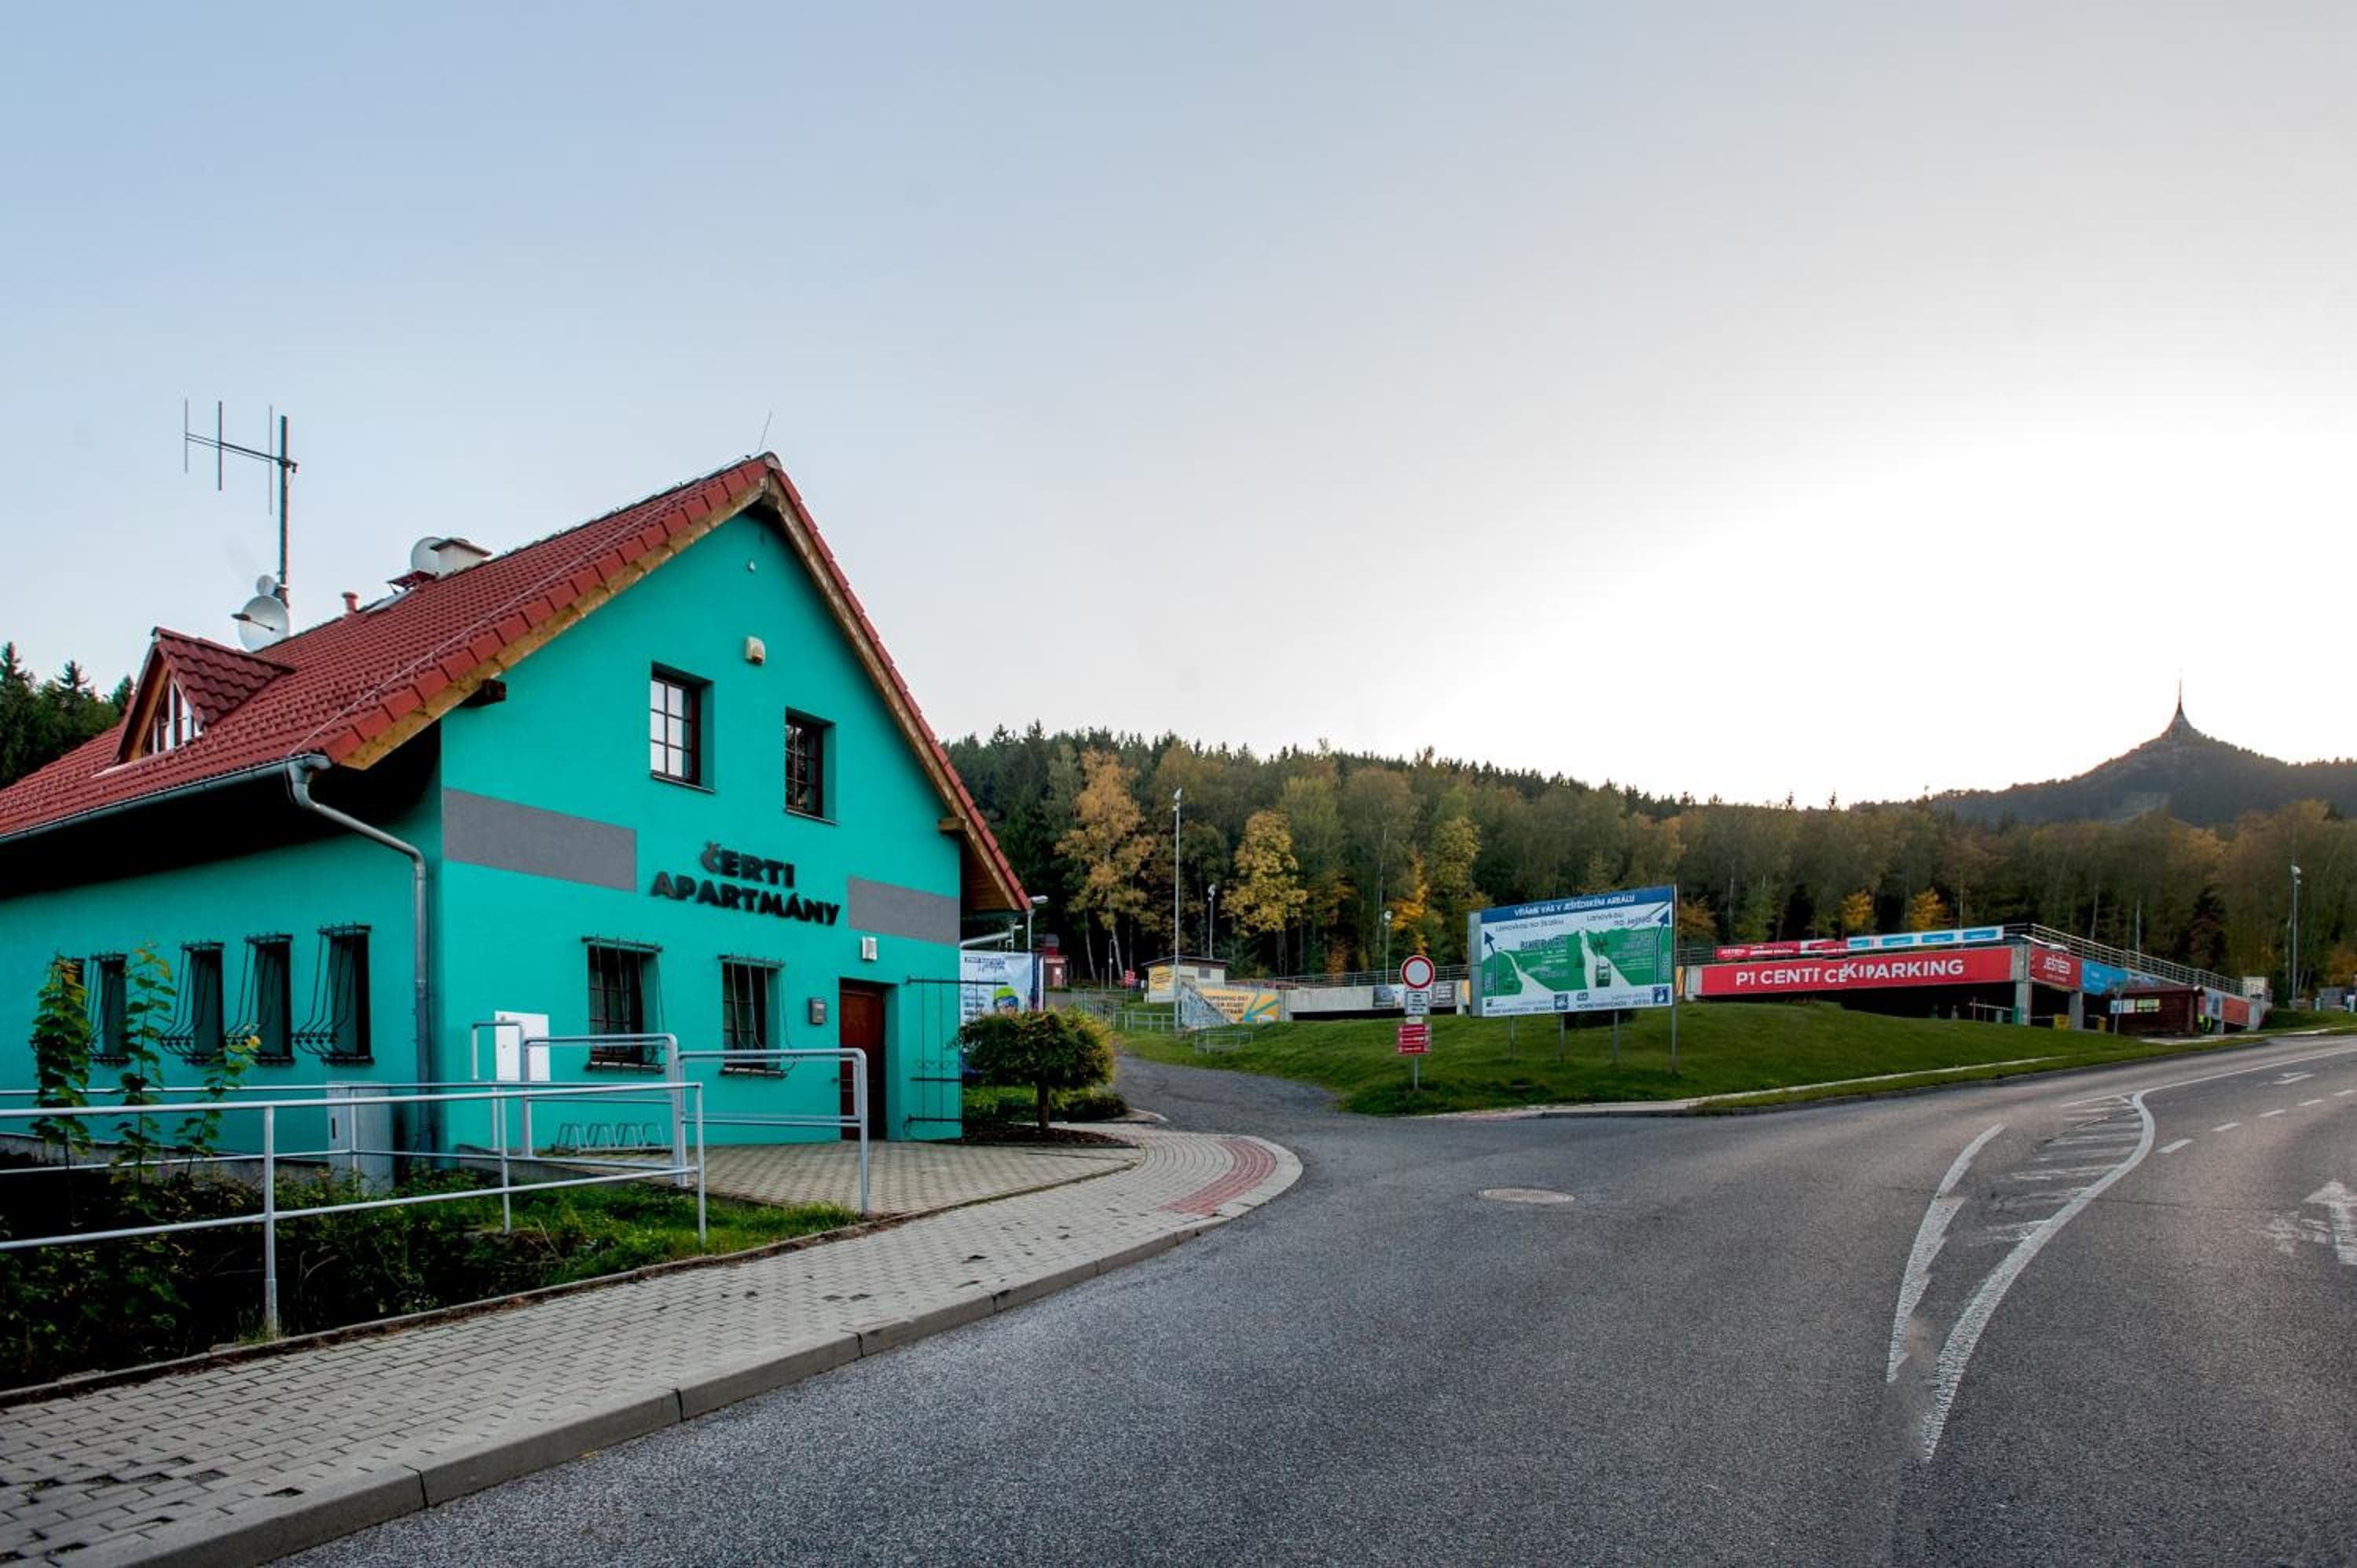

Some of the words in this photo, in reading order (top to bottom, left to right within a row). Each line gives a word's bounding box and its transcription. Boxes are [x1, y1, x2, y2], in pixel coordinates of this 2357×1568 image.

[701, 841, 795, 888] ČERTI
[651, 870, 840, 926] APARTMÁNY
[1736, 971, 1756, 986] P1
